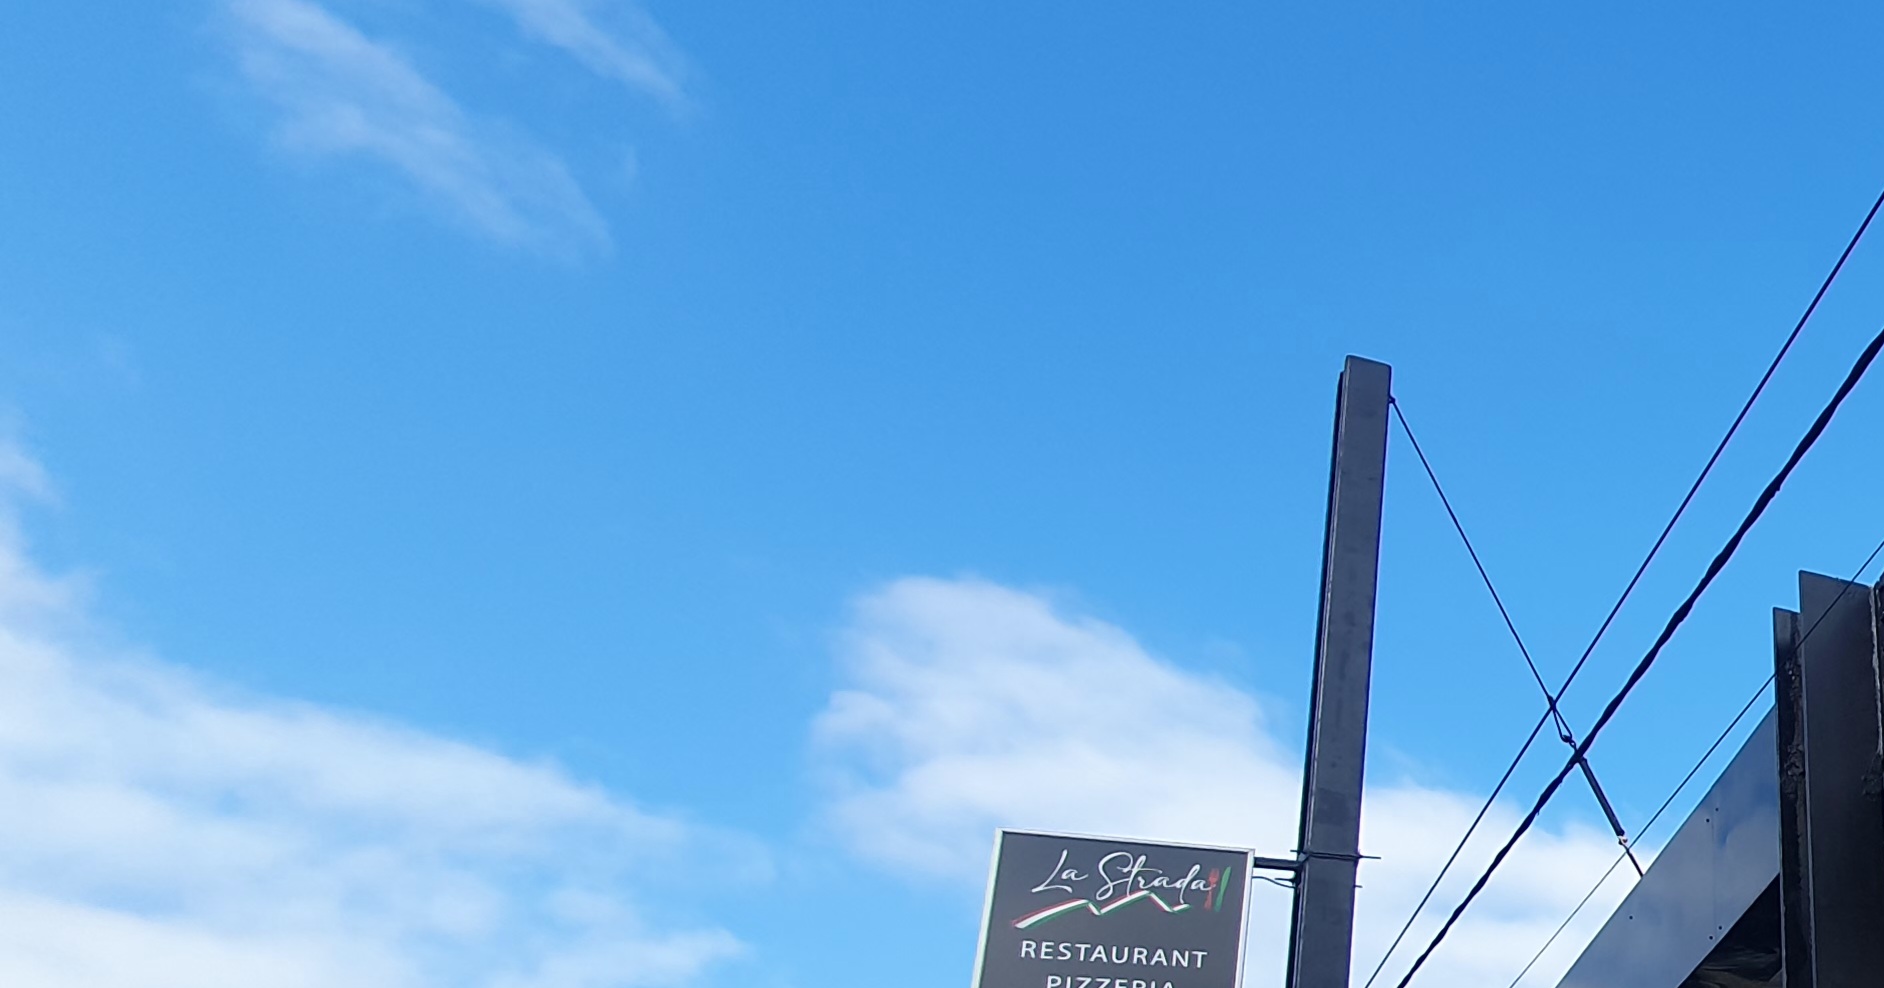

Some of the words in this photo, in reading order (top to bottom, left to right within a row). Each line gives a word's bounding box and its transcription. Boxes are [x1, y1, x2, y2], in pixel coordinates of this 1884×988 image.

[1031, 849, 1089, 894] La
[1096, 851, 1218, 904] Strada
[1019, 939, 1209, 969] RESTAURANT
